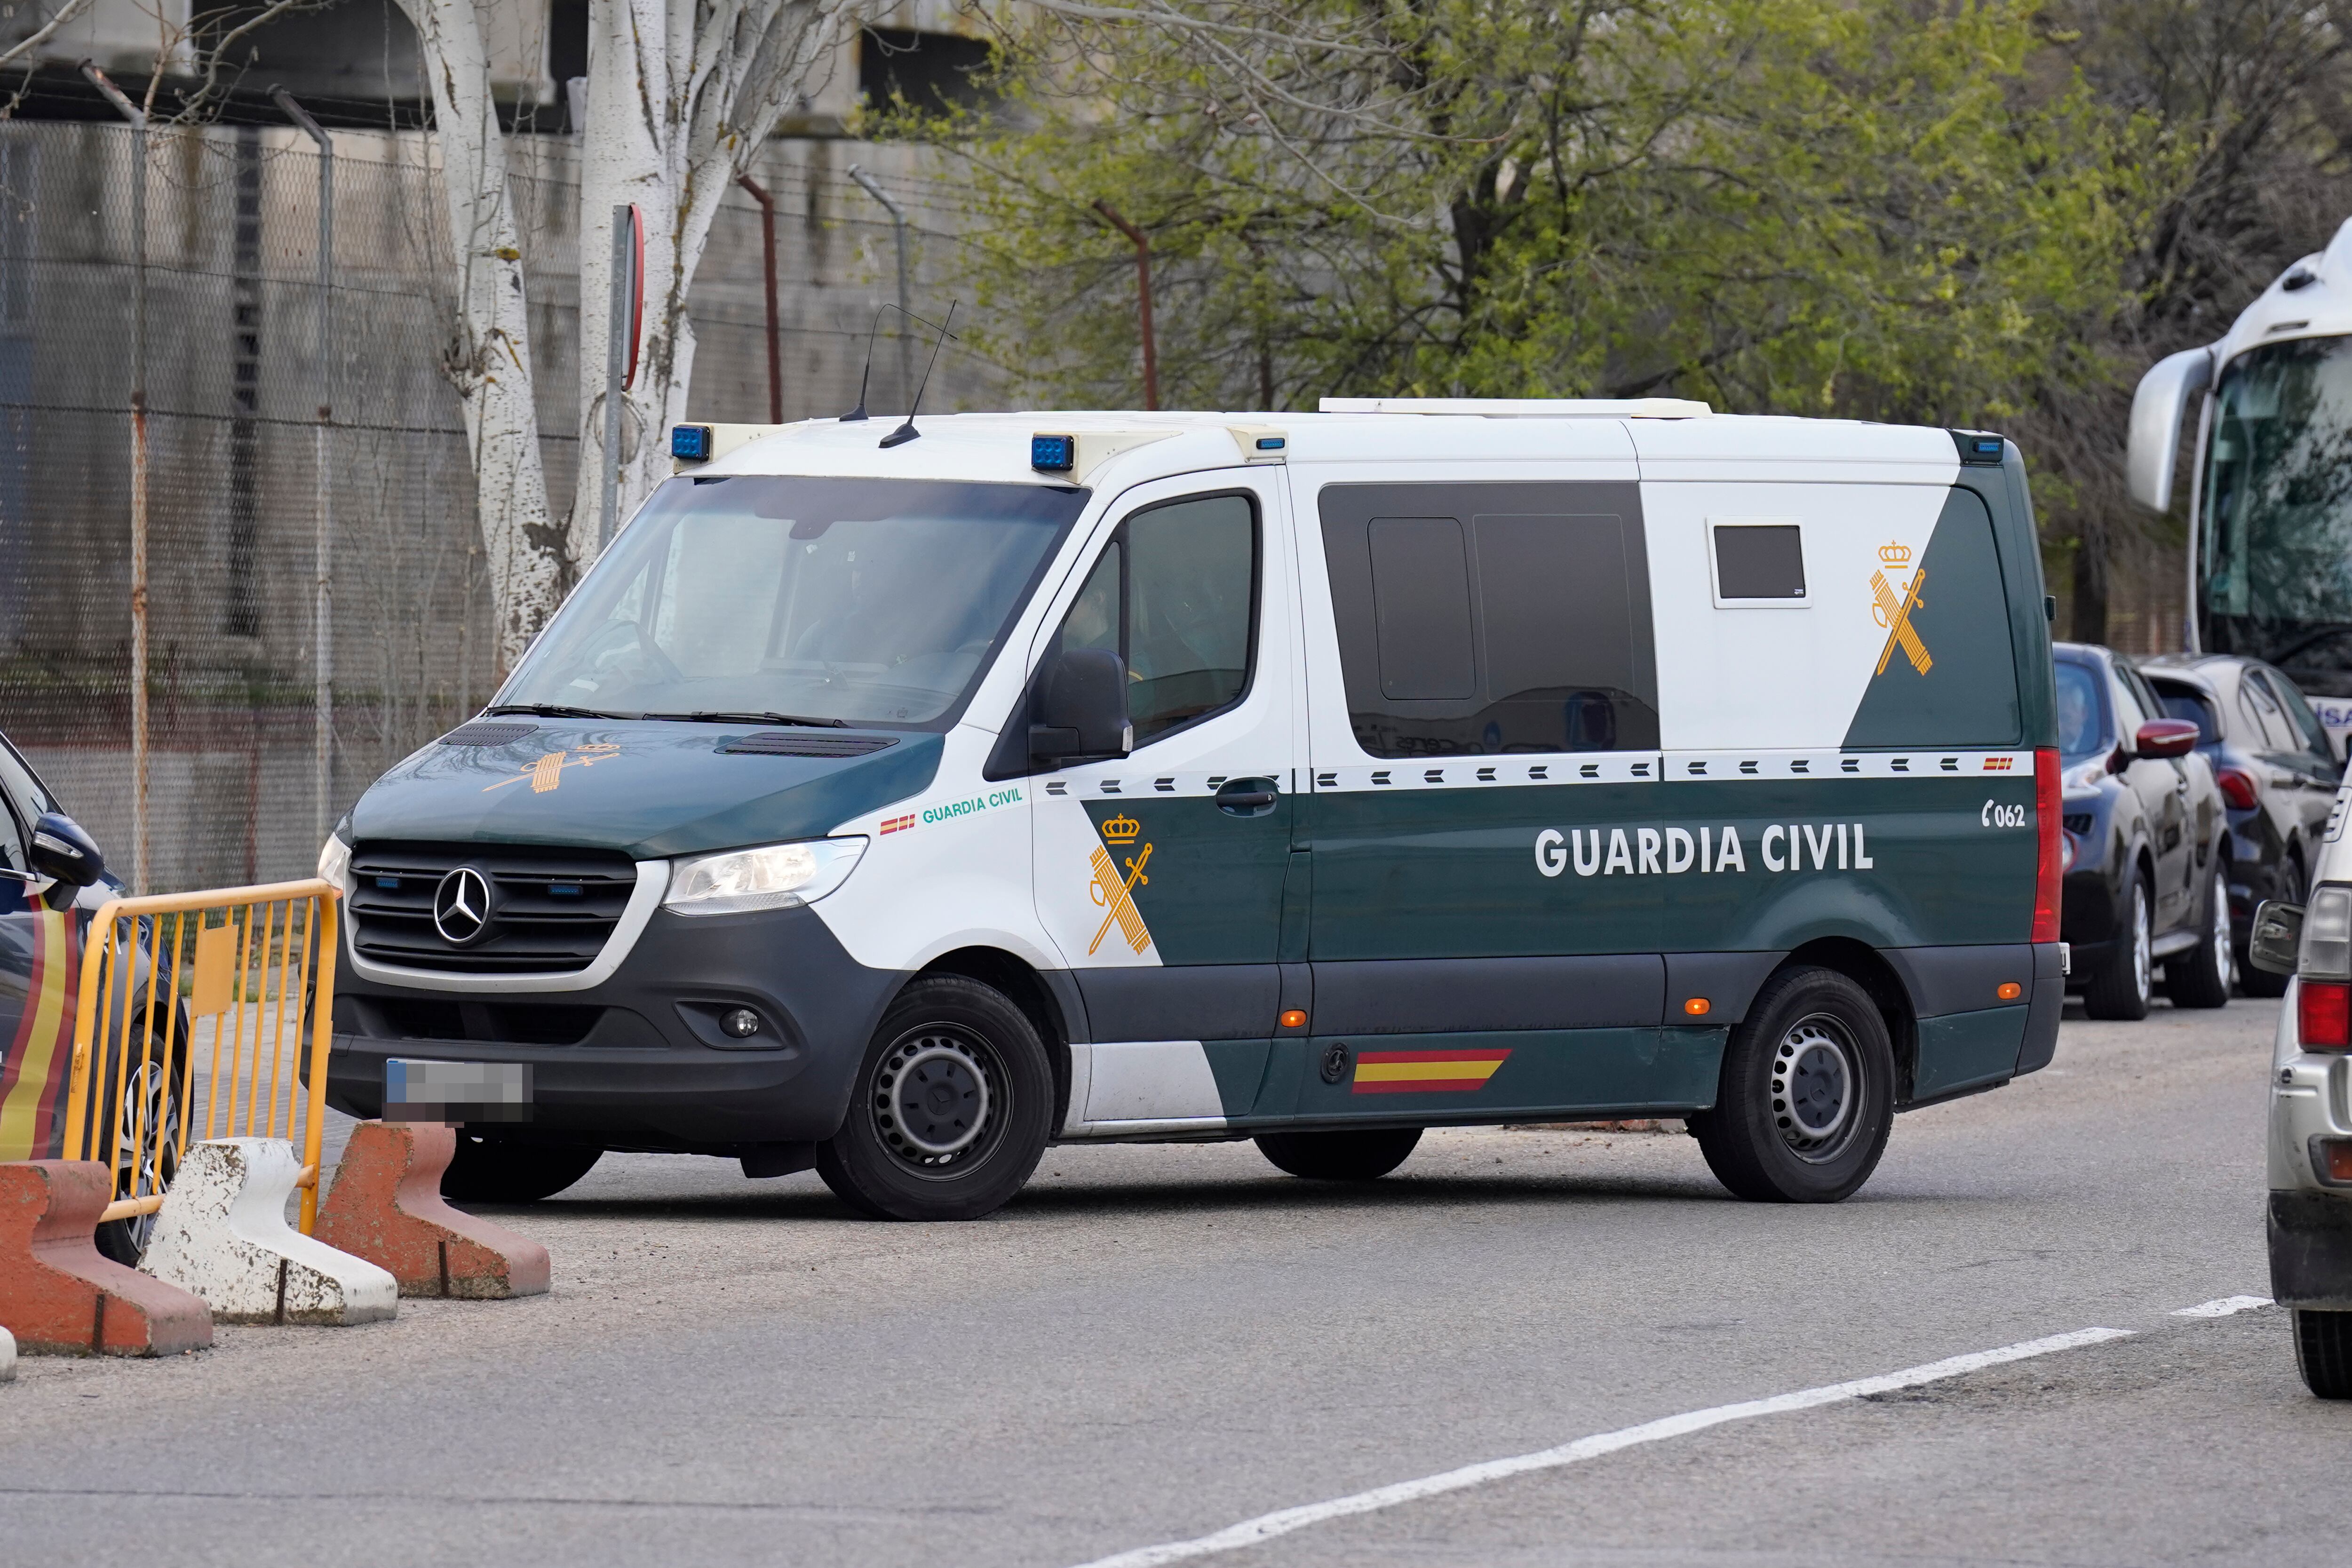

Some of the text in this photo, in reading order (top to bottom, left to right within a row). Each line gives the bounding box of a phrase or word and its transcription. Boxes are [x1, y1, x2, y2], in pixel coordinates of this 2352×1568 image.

[923, 788, 1023, 824] GUARDIA CIVIL
[1994, 804, 2025, 828] 062
[1535, 823, 1873, 877] GUARDIA CIVIL
